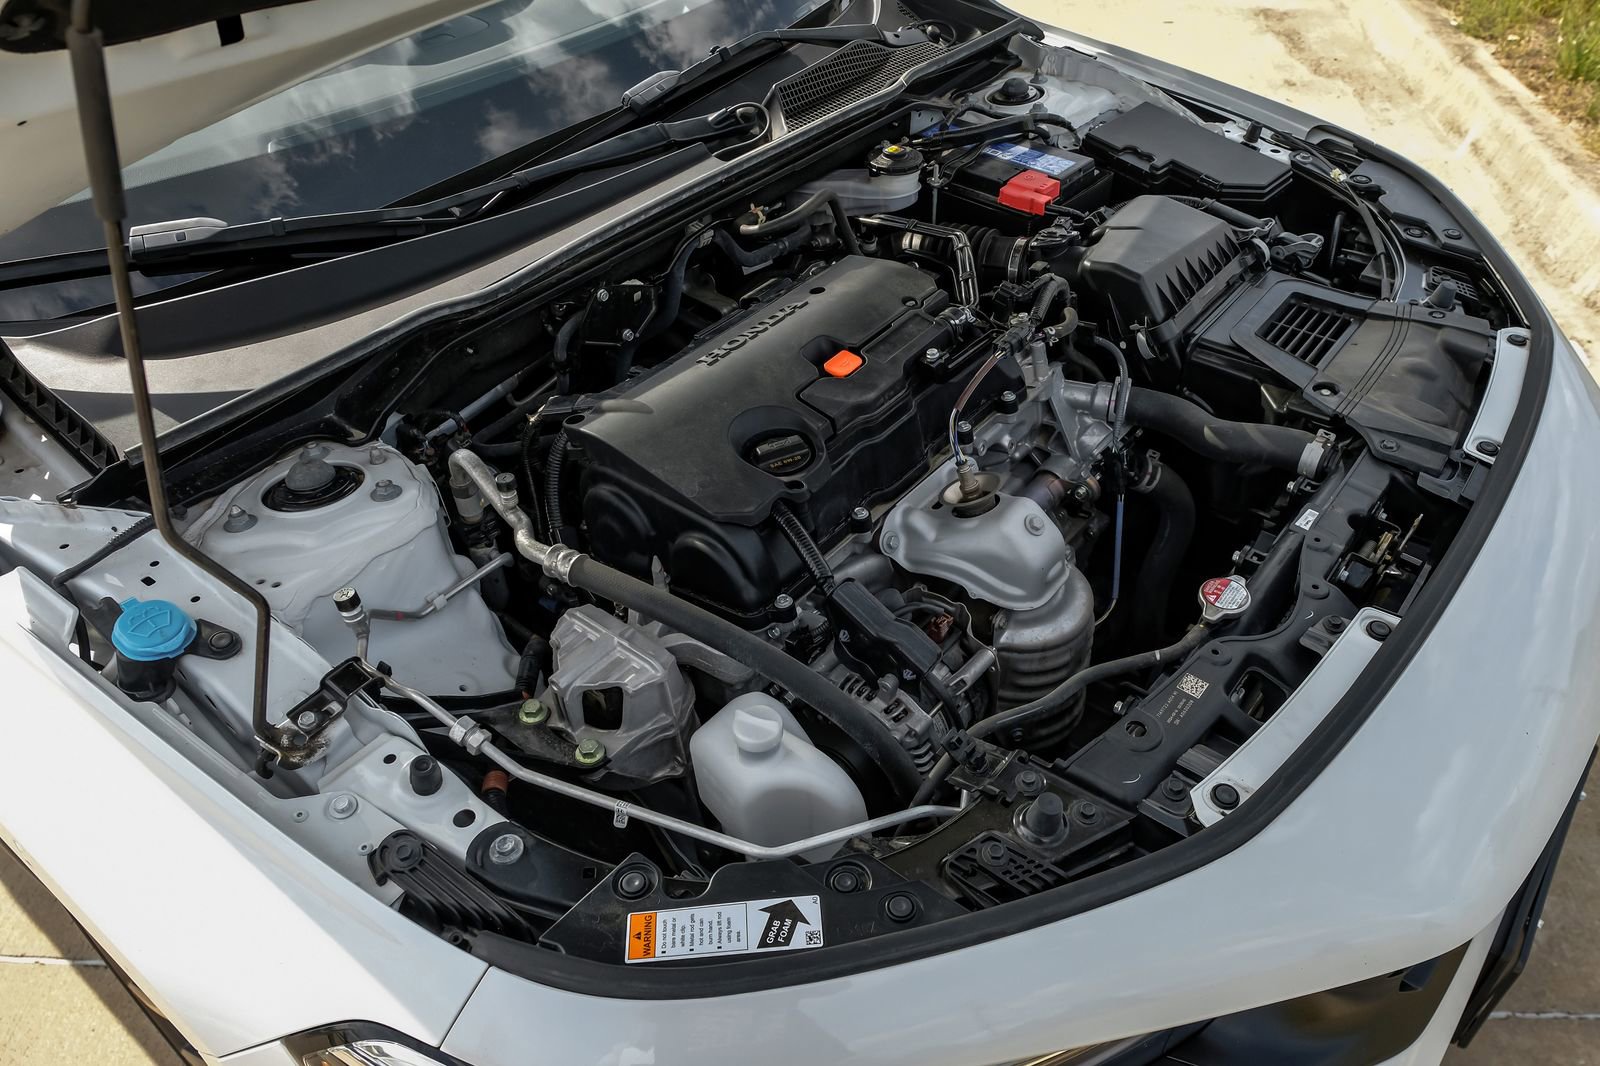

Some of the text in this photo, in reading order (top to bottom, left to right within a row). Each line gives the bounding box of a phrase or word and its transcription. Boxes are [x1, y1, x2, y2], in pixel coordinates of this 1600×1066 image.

[696, 301, 809, 366] HONDA
[643, 915, 652, 956] WARNING
[766, 920, 780, 943] GRAB
[777, 919, 792, 942] FOAM
[661, 941, 667, 949] Do
